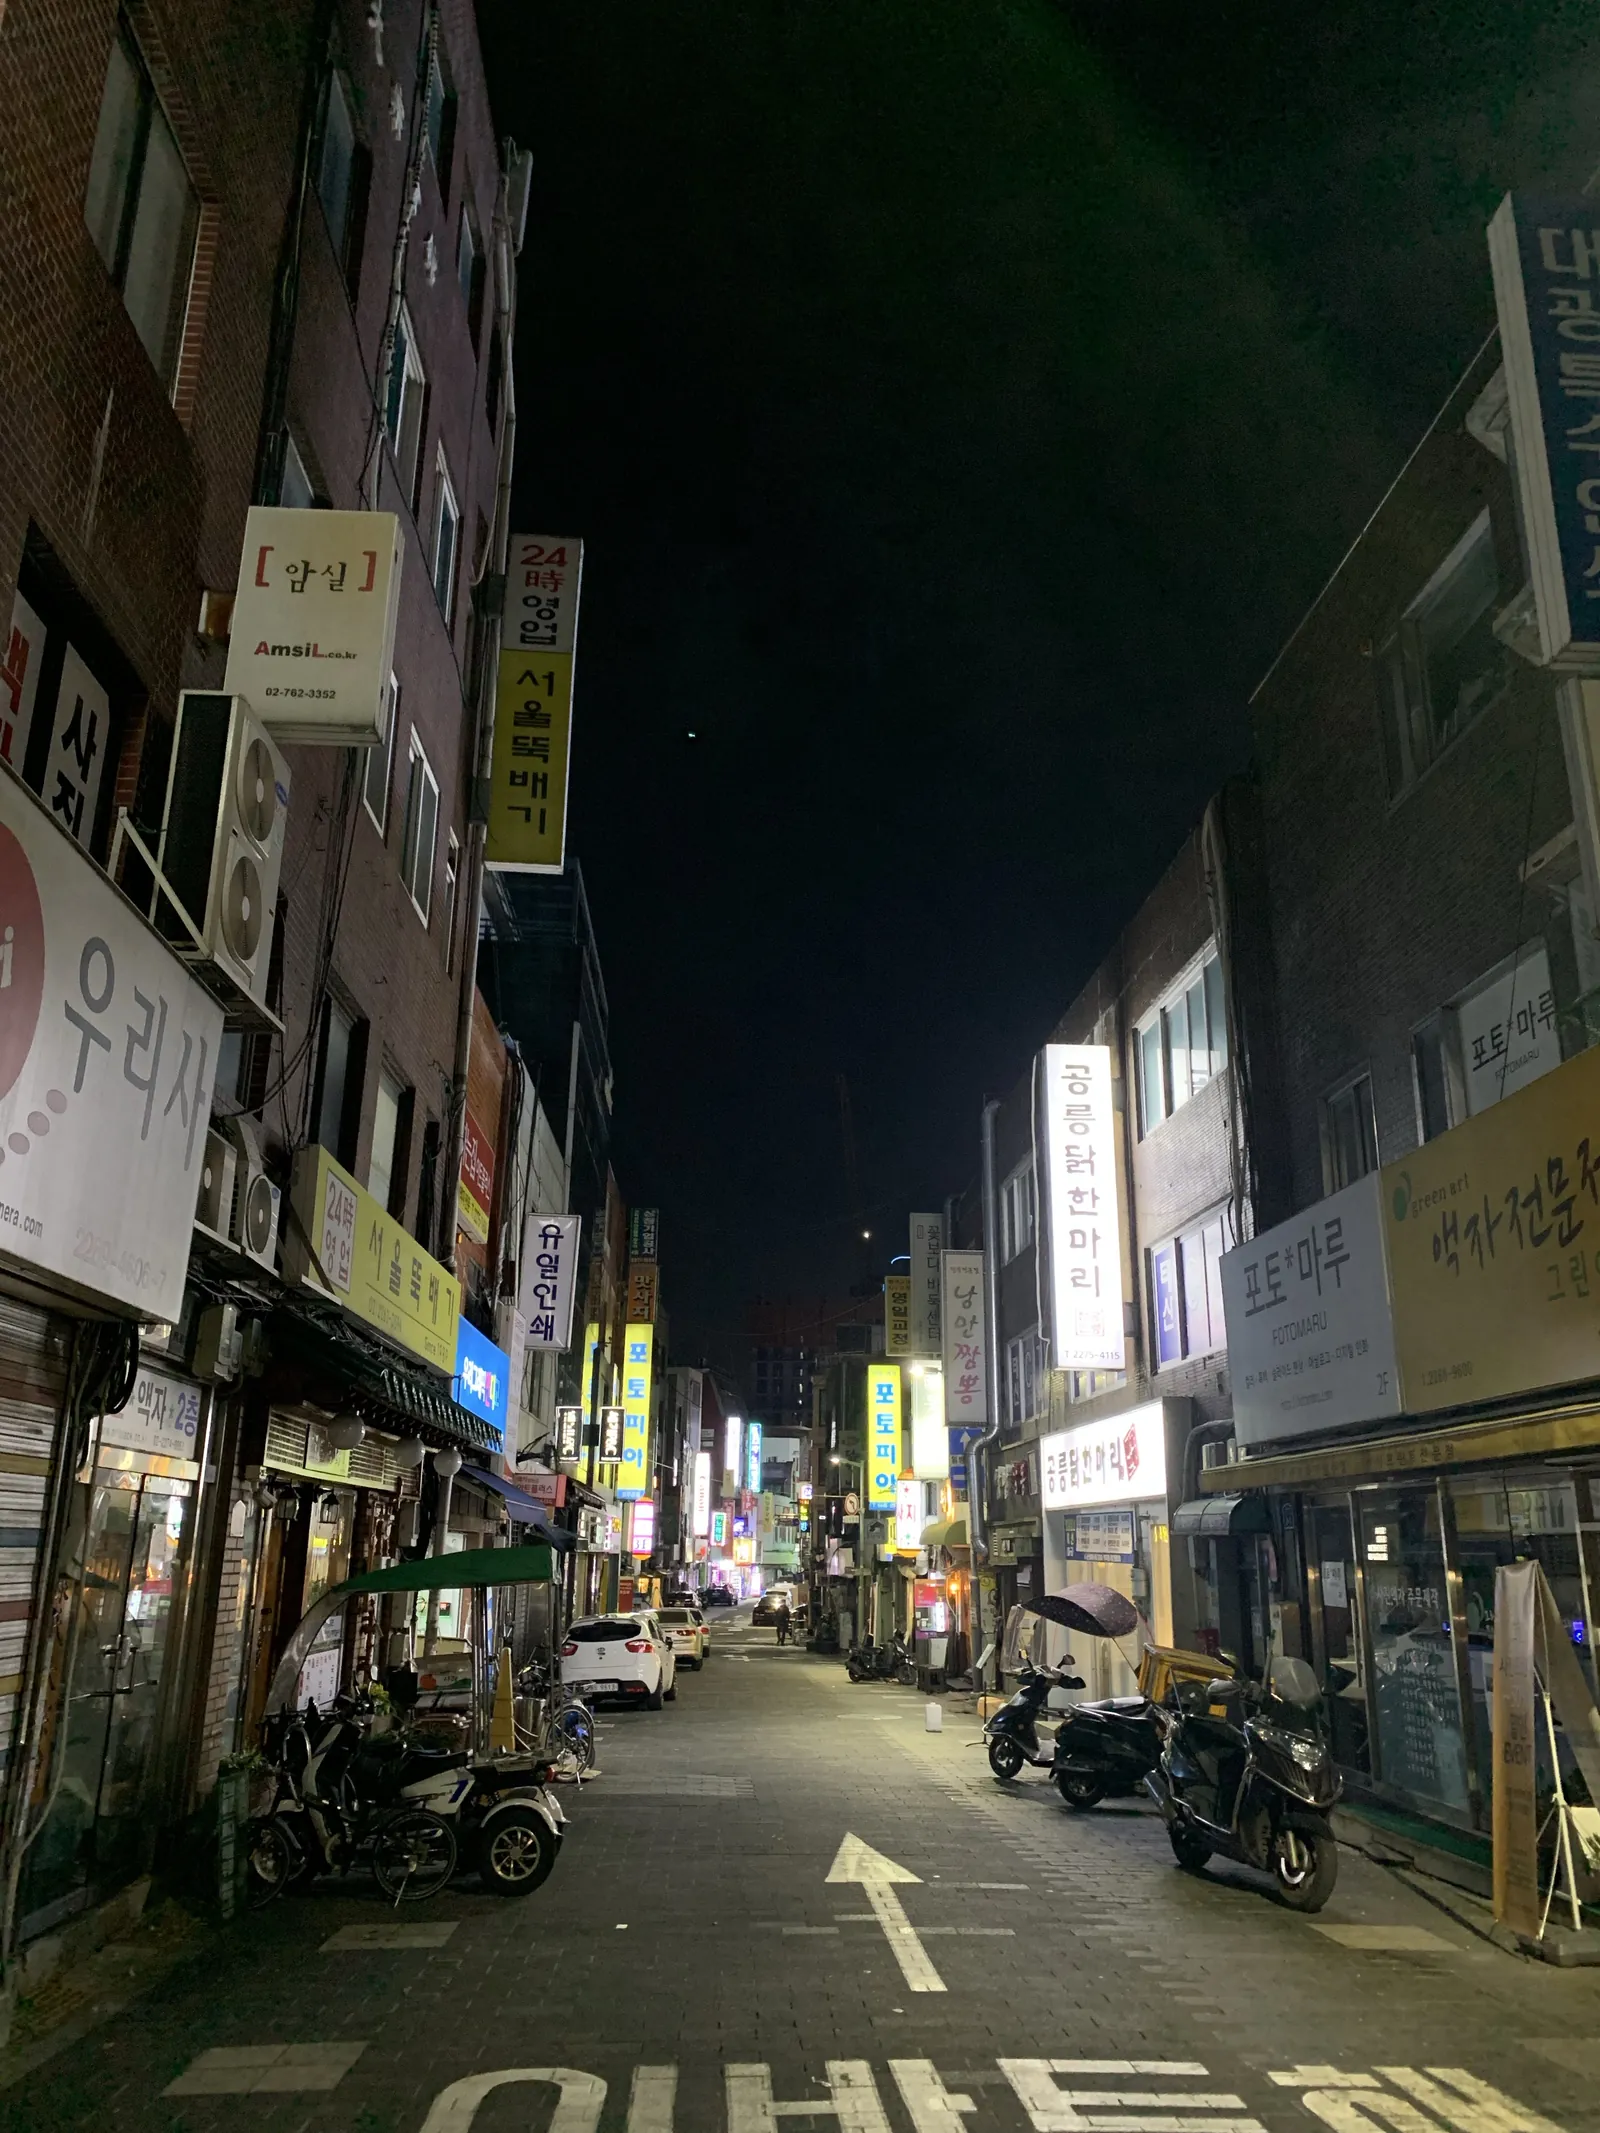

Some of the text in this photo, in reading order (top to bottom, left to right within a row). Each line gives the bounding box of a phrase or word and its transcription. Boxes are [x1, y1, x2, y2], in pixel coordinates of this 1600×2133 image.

[254, 641, 358, 660] AmsiL.co.kr
[265, 687, 337, 700] 02-762-3352
[508, 669, 555, 836] 서울뚝배기
[324, 1228, 352, 1284] 영업
[368, 1219, 455, 1337] 서울뚝배기
[529, 1223, 564, 1342] 유일인쇄
[632, 1275, 653, 1320] 맛사지
[891, 1291, 908, 1346] 영일교정
[1271, 1311, 1329, 1347] FOTOMARU
[138, 1380, 200, 1438] 액자 2층
[623, 1342, 648, 1468] 포토피아
[1375, 1371, 1390, 1396] 2F
[875, 1383, 897, 1494] 포토피아
